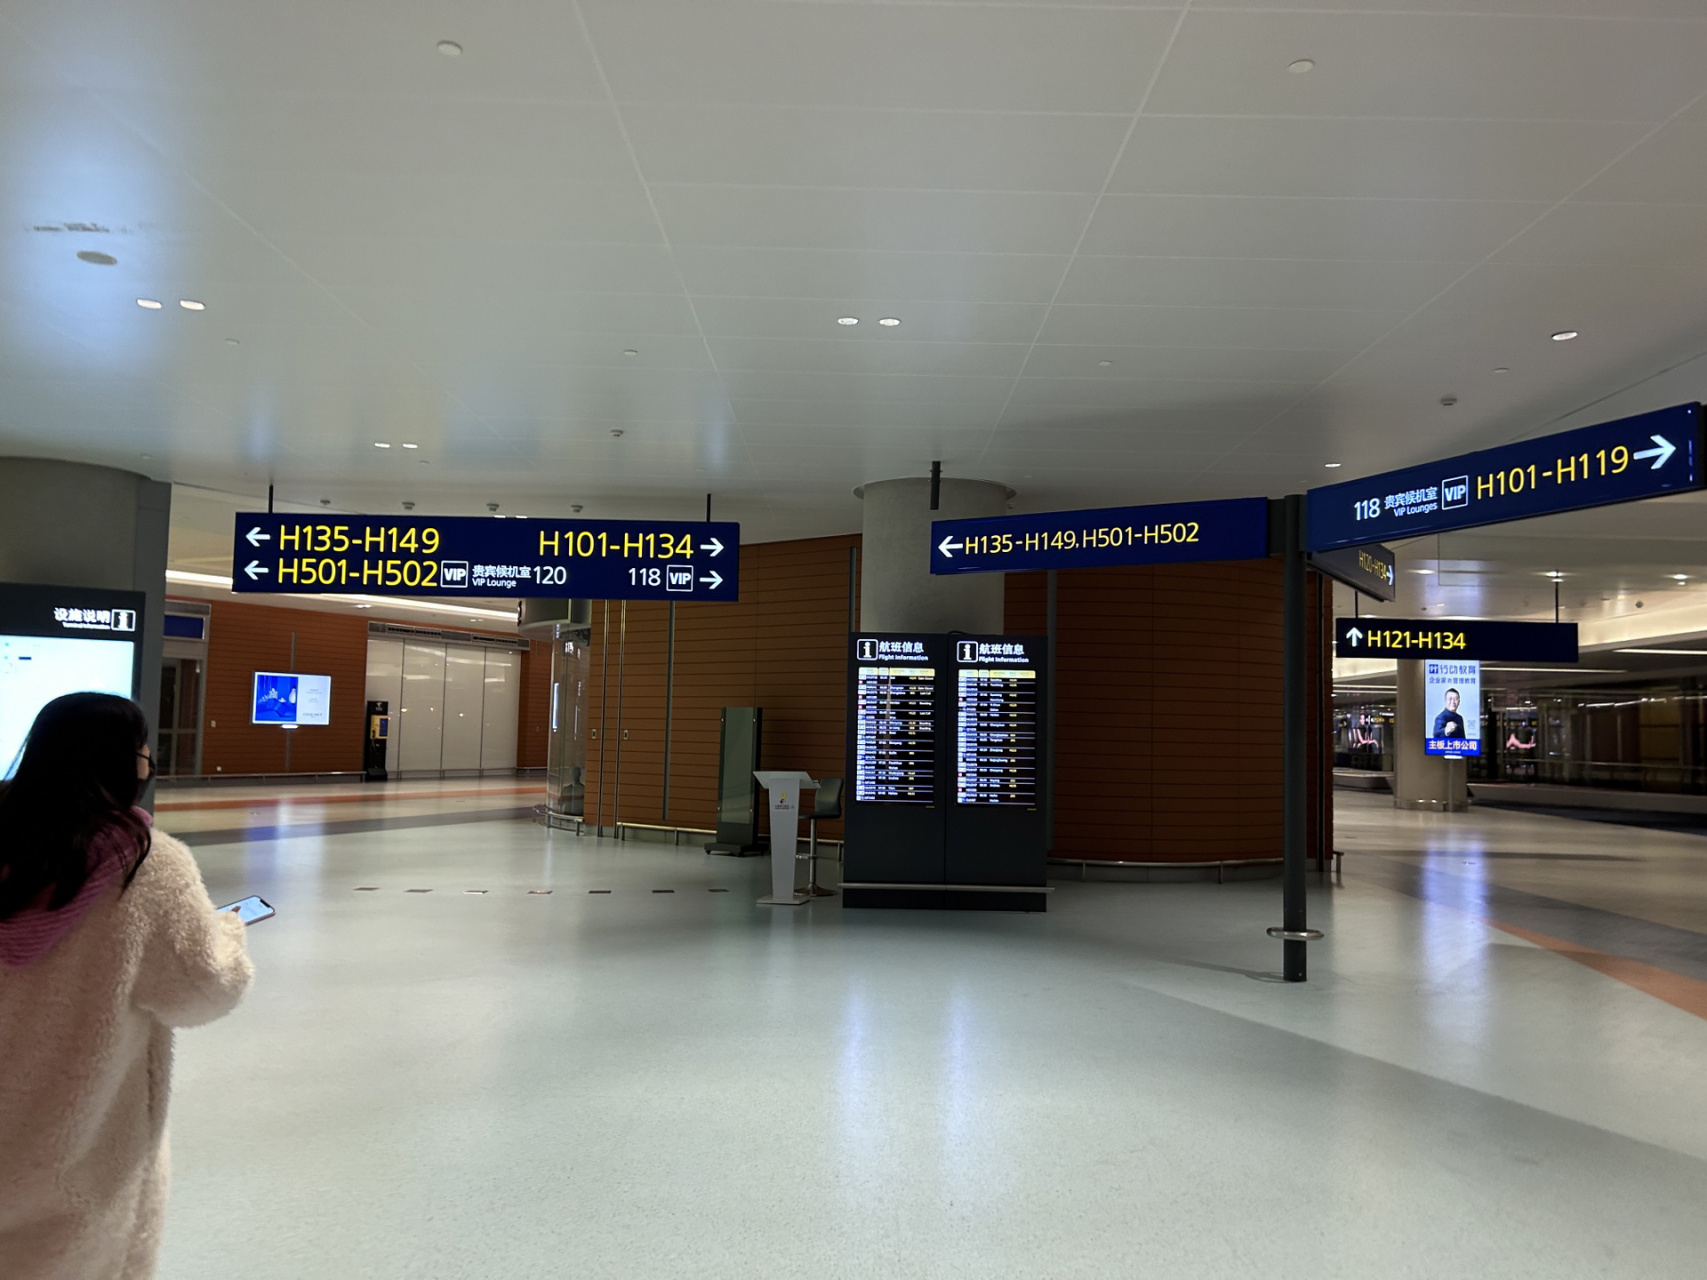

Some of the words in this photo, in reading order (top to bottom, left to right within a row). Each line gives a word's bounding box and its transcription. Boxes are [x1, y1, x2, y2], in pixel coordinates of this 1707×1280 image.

[1354, 497, 1381, 521] 118
[1384, 486, 1438, 509] 贵宾候机室
[1445, 484, 1466, 502] VIP
[1476, 445, 1629, 500] H101-H119
[1393, 506, 1406, 517] VIP
[1406, 502, 1439, 516] Lounges
[278, 524, 440, 554] H135-H149
[538, 530, 694, 559] H101-H134
[277, 557, 438, 588] H501-H502
[443, 568, 467, 581] VIP
[472, 564, 532, 578] 贵宾候机室
[533, 565, 567, 585] 120
[628, 567, 661, 587] 118
[669, 572, 691, 585] VIP
[472, 578, 486, 587] VIP
[486, 578, 517, 589] Lounge
[879, 641, 925, 654] 航班信息
[979, 643, 1025, 656] 航班信息
[1367, 630, 1466, 650] H121-H134
[1428, 740, 1478, 751] 主板上市公司
